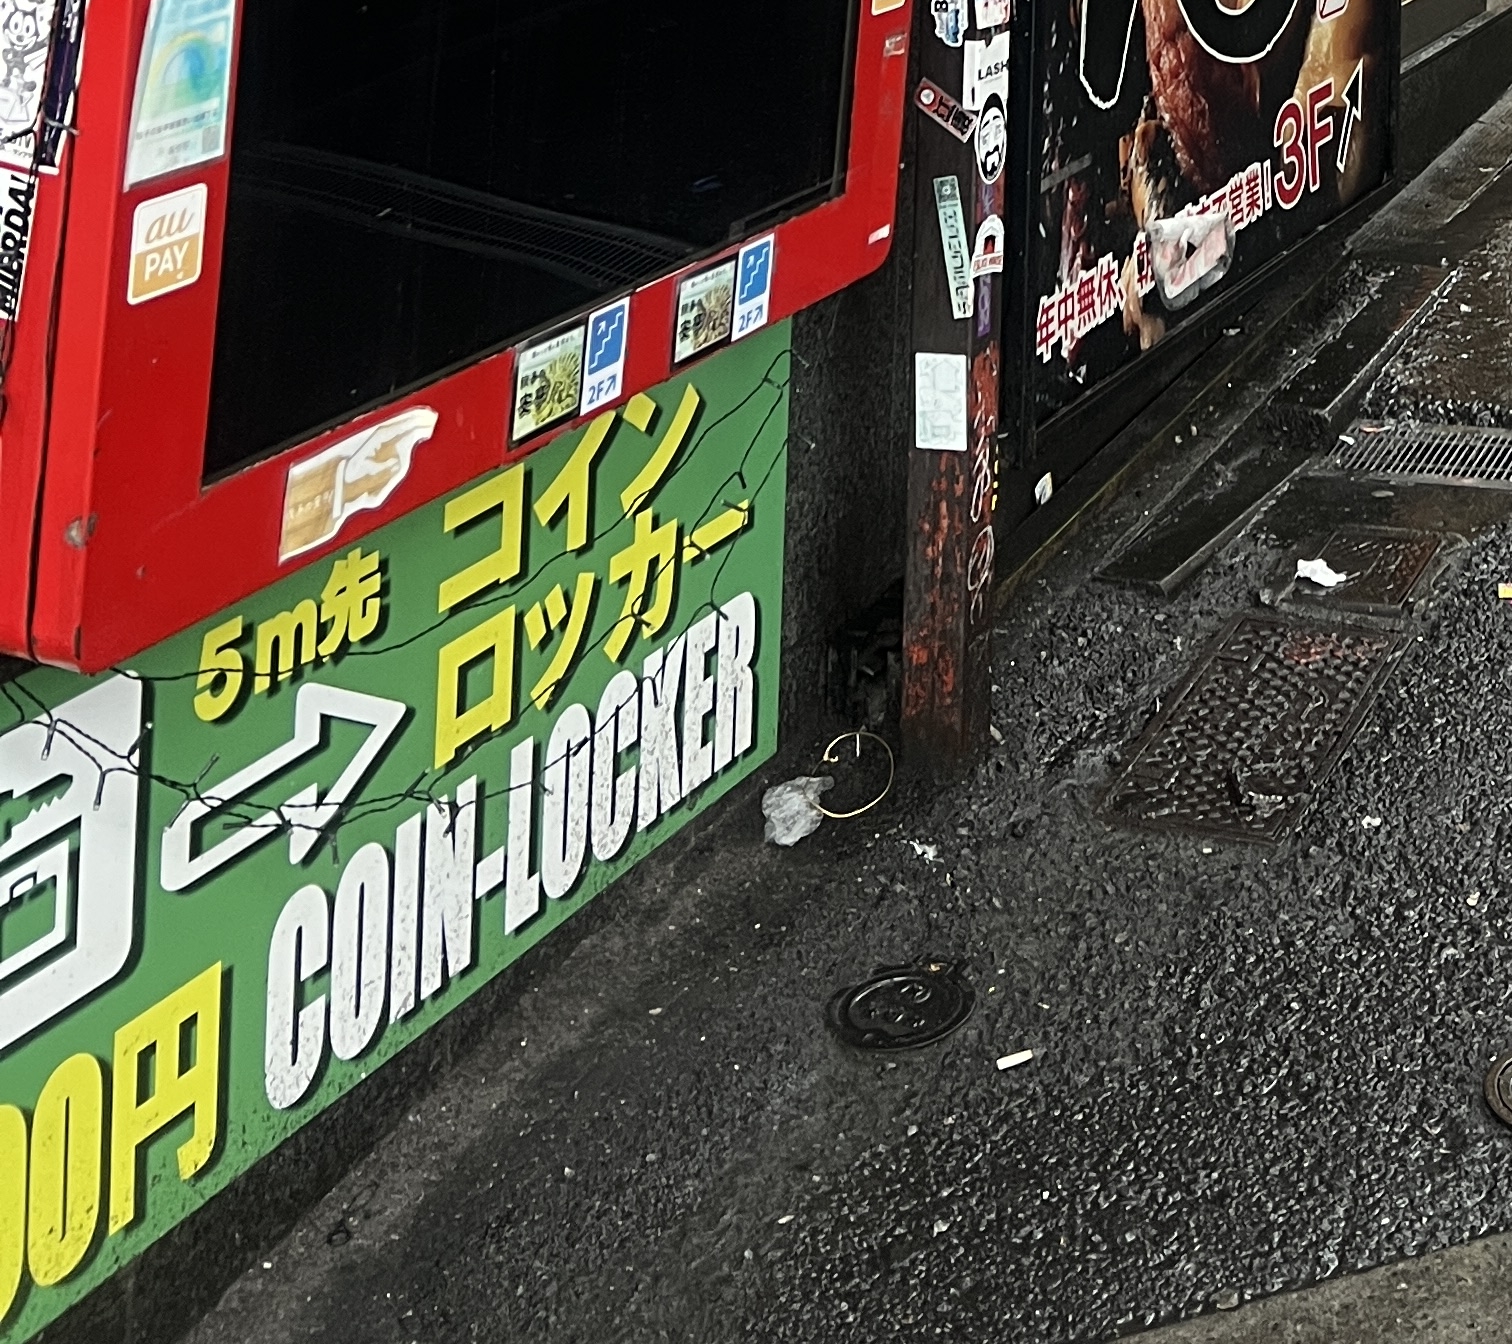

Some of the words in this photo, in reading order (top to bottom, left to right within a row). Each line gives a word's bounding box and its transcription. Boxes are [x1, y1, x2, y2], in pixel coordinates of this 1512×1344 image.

[144, 208, 196, 245] au
[1273, 76, 1335, 210] 3F
[143, 239, 191, 282] PAY
[436, 382, 704, 615] コイン
[192, 545, 390, 723] 5m先
[433, 498, 752, 770] ロッカー
[263, 590, 759, 1112] COIN-LOCKER
